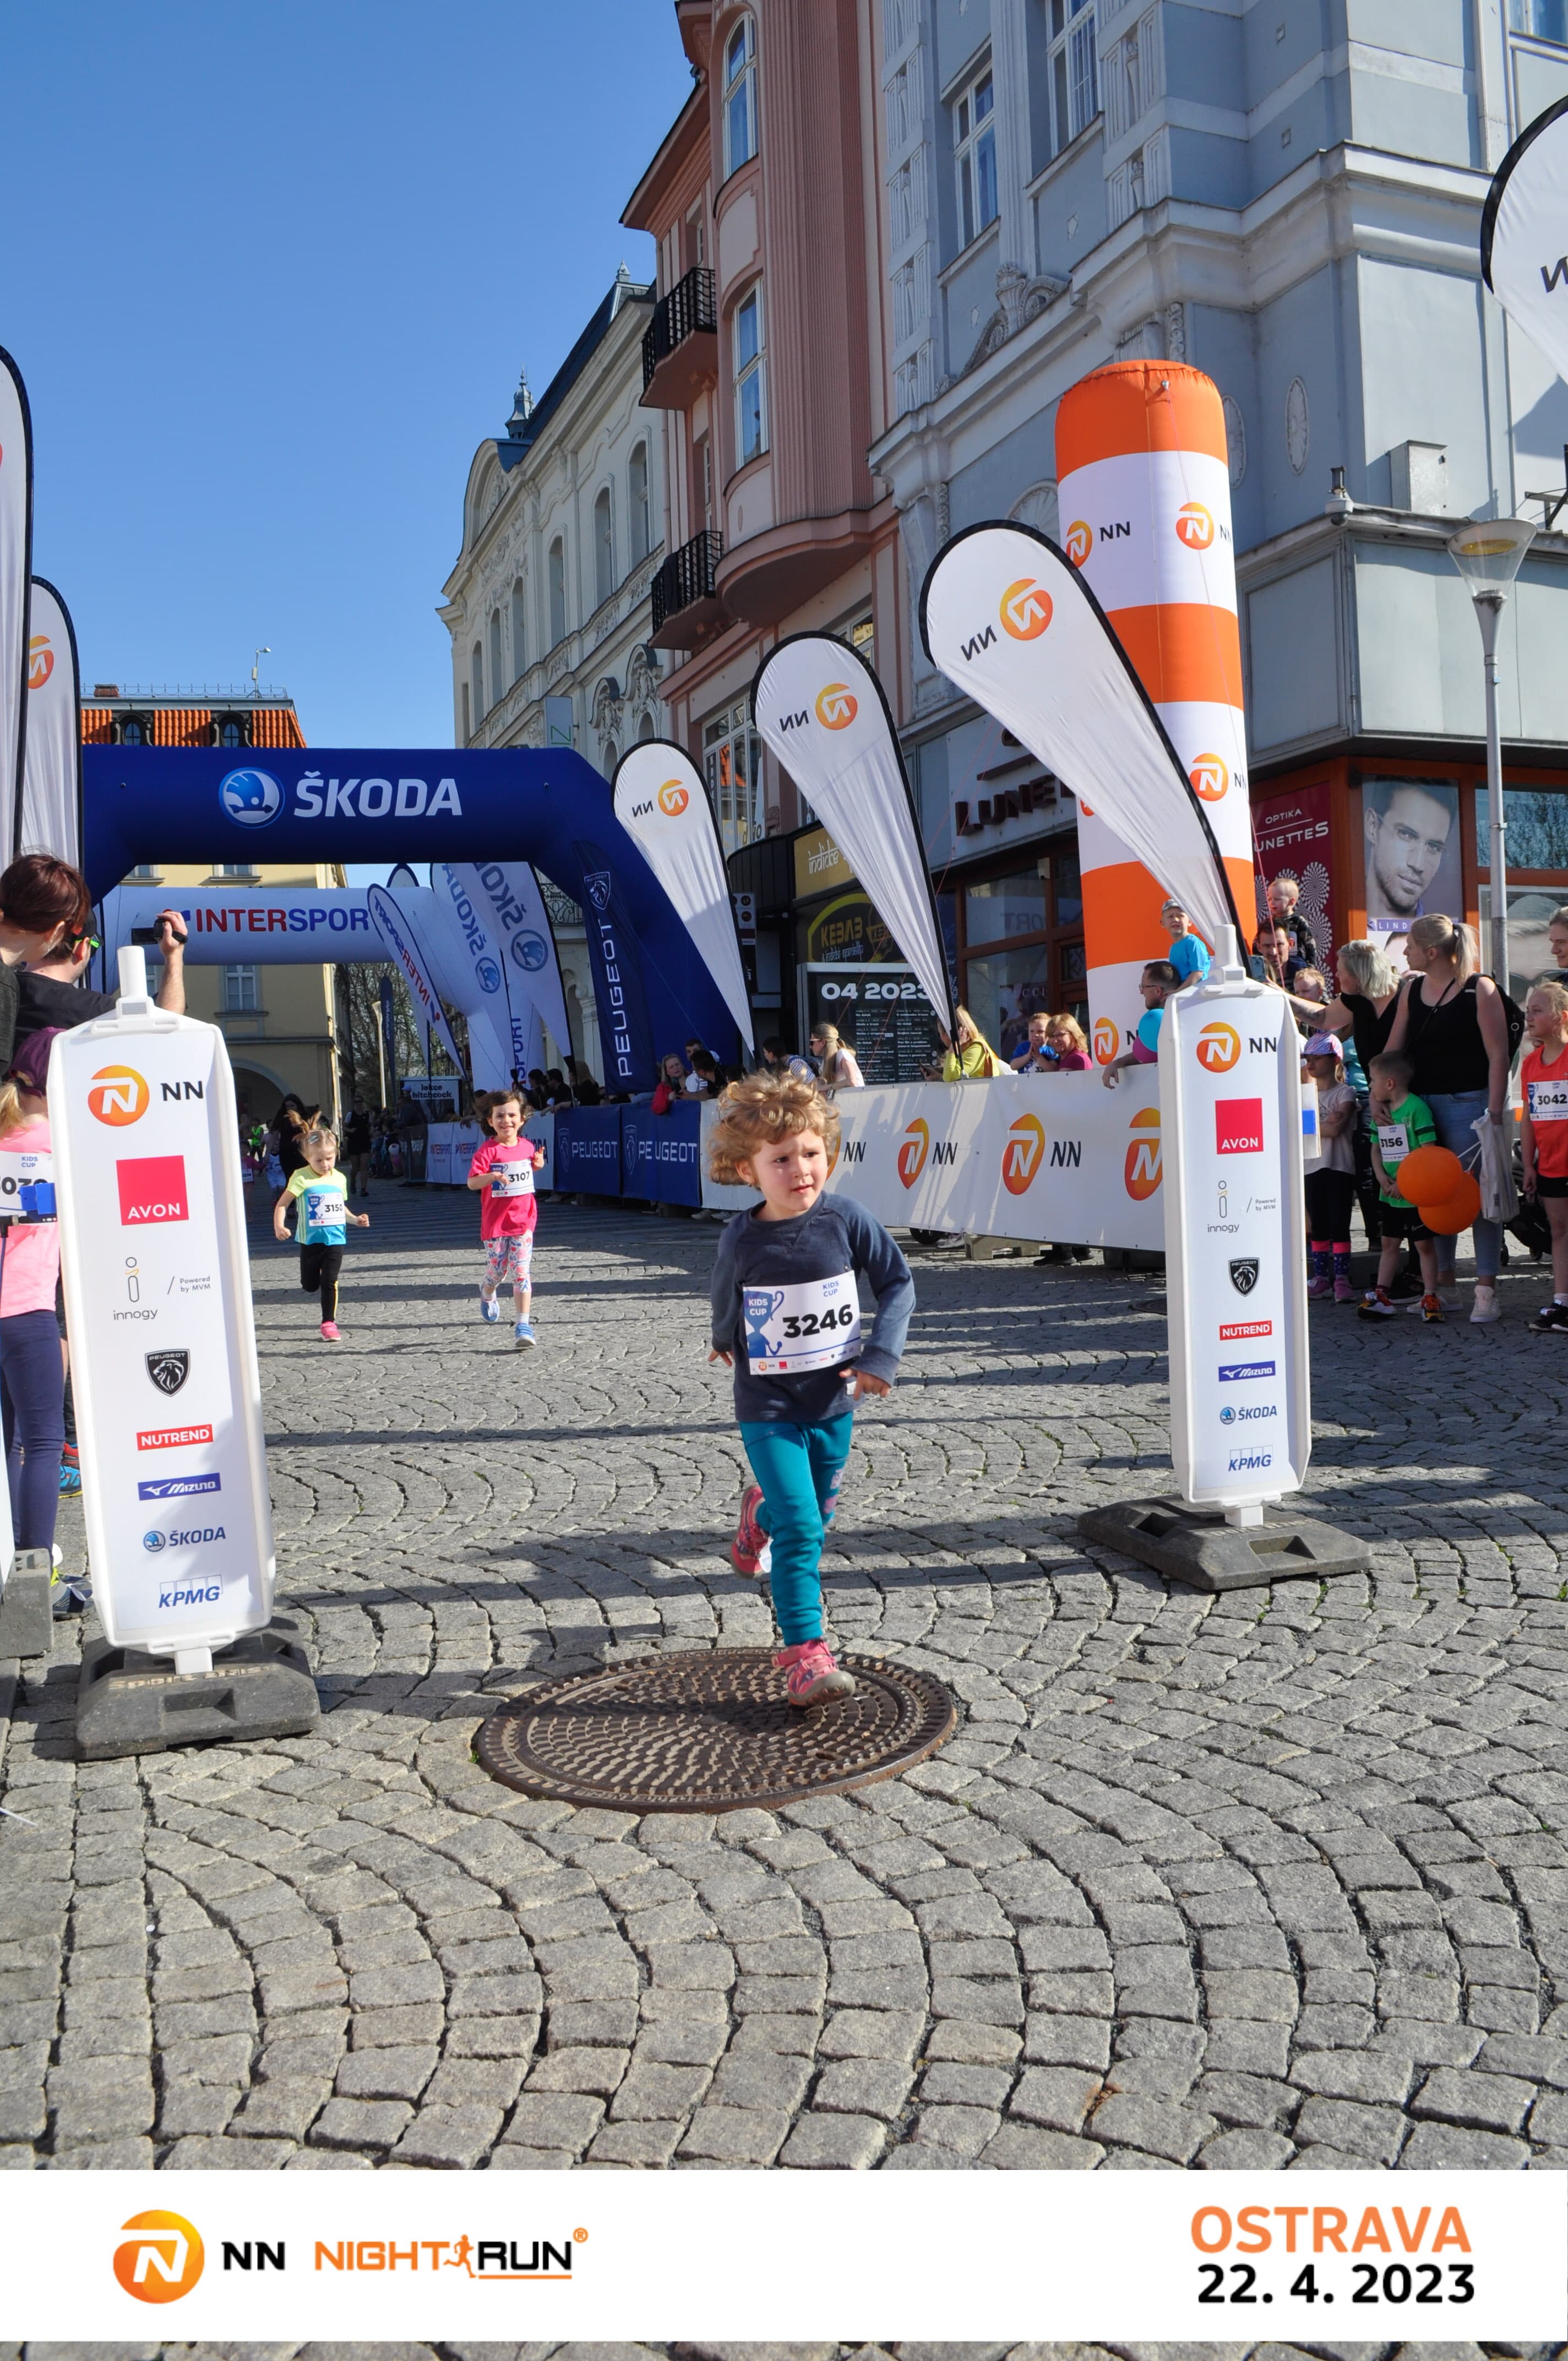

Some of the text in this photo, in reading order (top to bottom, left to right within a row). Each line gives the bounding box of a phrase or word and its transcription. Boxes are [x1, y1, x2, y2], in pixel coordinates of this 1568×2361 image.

[1099, 521, 1131, 542] NN
[293, 771, 462, 818] ŠKODA
[955, 773, 1076, 836] LUNE
[1265, 808, 1302, 824] OPTIKA
[1254, 821, 1329, 852] UNETTES
[197, 908, 369, 933] INTERSPOR
[1379, 922, 1408, 930] LIND
[598, 918, 633, 1077] PEUGEOT
[821, 983, 858, 1000] 04
[865, 982, 930, 1000] 2023
[1249, 1037, 1277, 1054] NN
[161, 1080, 204, 1102] NN
[1537, 1094, 1567, 1106] 3042
[571, 1140, 618, 1159] PEUGEOT
[639, 1140, 698, 1163] PEUGEOT
[843, 1141, 866, 1163] NN
[1221, 1138, 1259, 1150] AVON
[932, 1142, 957, 1166] NN
[1050, 1140, 1081, 1168] NN
[508, 1171, 530, 1183] 3107
[128, 1203, 181, 1220] AVON
[324, 1204, 343, 1213] 3150
[1207, 1223, 1240, 1234] innogy
[823, 1281, 839, 1291] KIDS
[823, 1288, 838, 1298] CUP
[748, 1298, 768, 1307] KIDS
[113, 1307, 158, 1321] innogy
[749, 1308, 767, 1316] CUP
[782, 1304, 853, 1339] 3246
[1222, 1324, 1271, 1338] NUTREND
[149, 1352, 186, 1361] PEUGEOT
[1238, 1405, 1277, 1421] ŠKODA
[141, 1428, 210, 1448] NUTREND
[1228, 1454, 1272, 1472] KPMG
[169, 1526, 227, 1547] ŠKODA
[159, 1585, 220, 1608] KPMG
